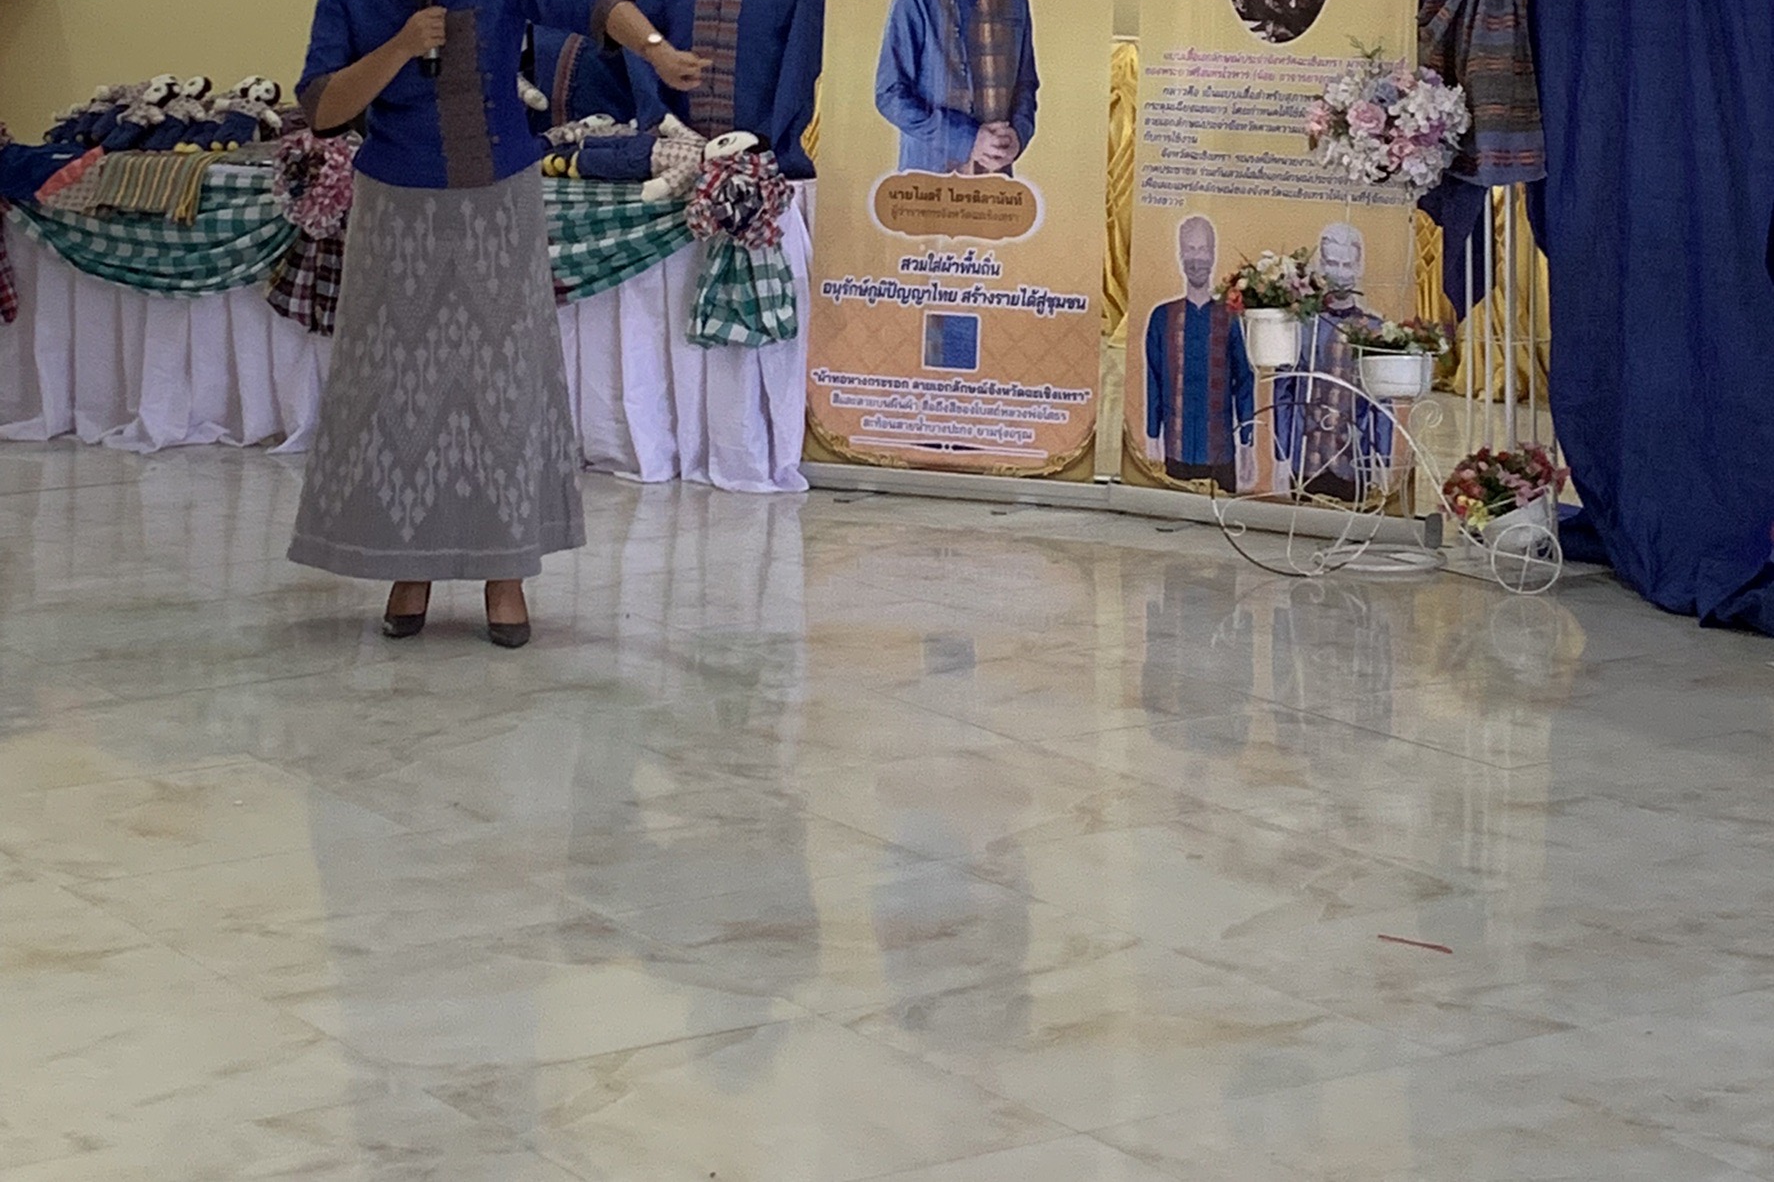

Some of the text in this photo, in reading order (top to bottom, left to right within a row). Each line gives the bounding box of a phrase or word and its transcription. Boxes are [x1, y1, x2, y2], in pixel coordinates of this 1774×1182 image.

[900, 250, 1002, 276] สวมใส่ผ้าพื้นถิ่น
[822, 278, 1087, 316] อนุรักษ์ภูมิปัญญาไทย สร้างรายได้สู่ชุมชน
